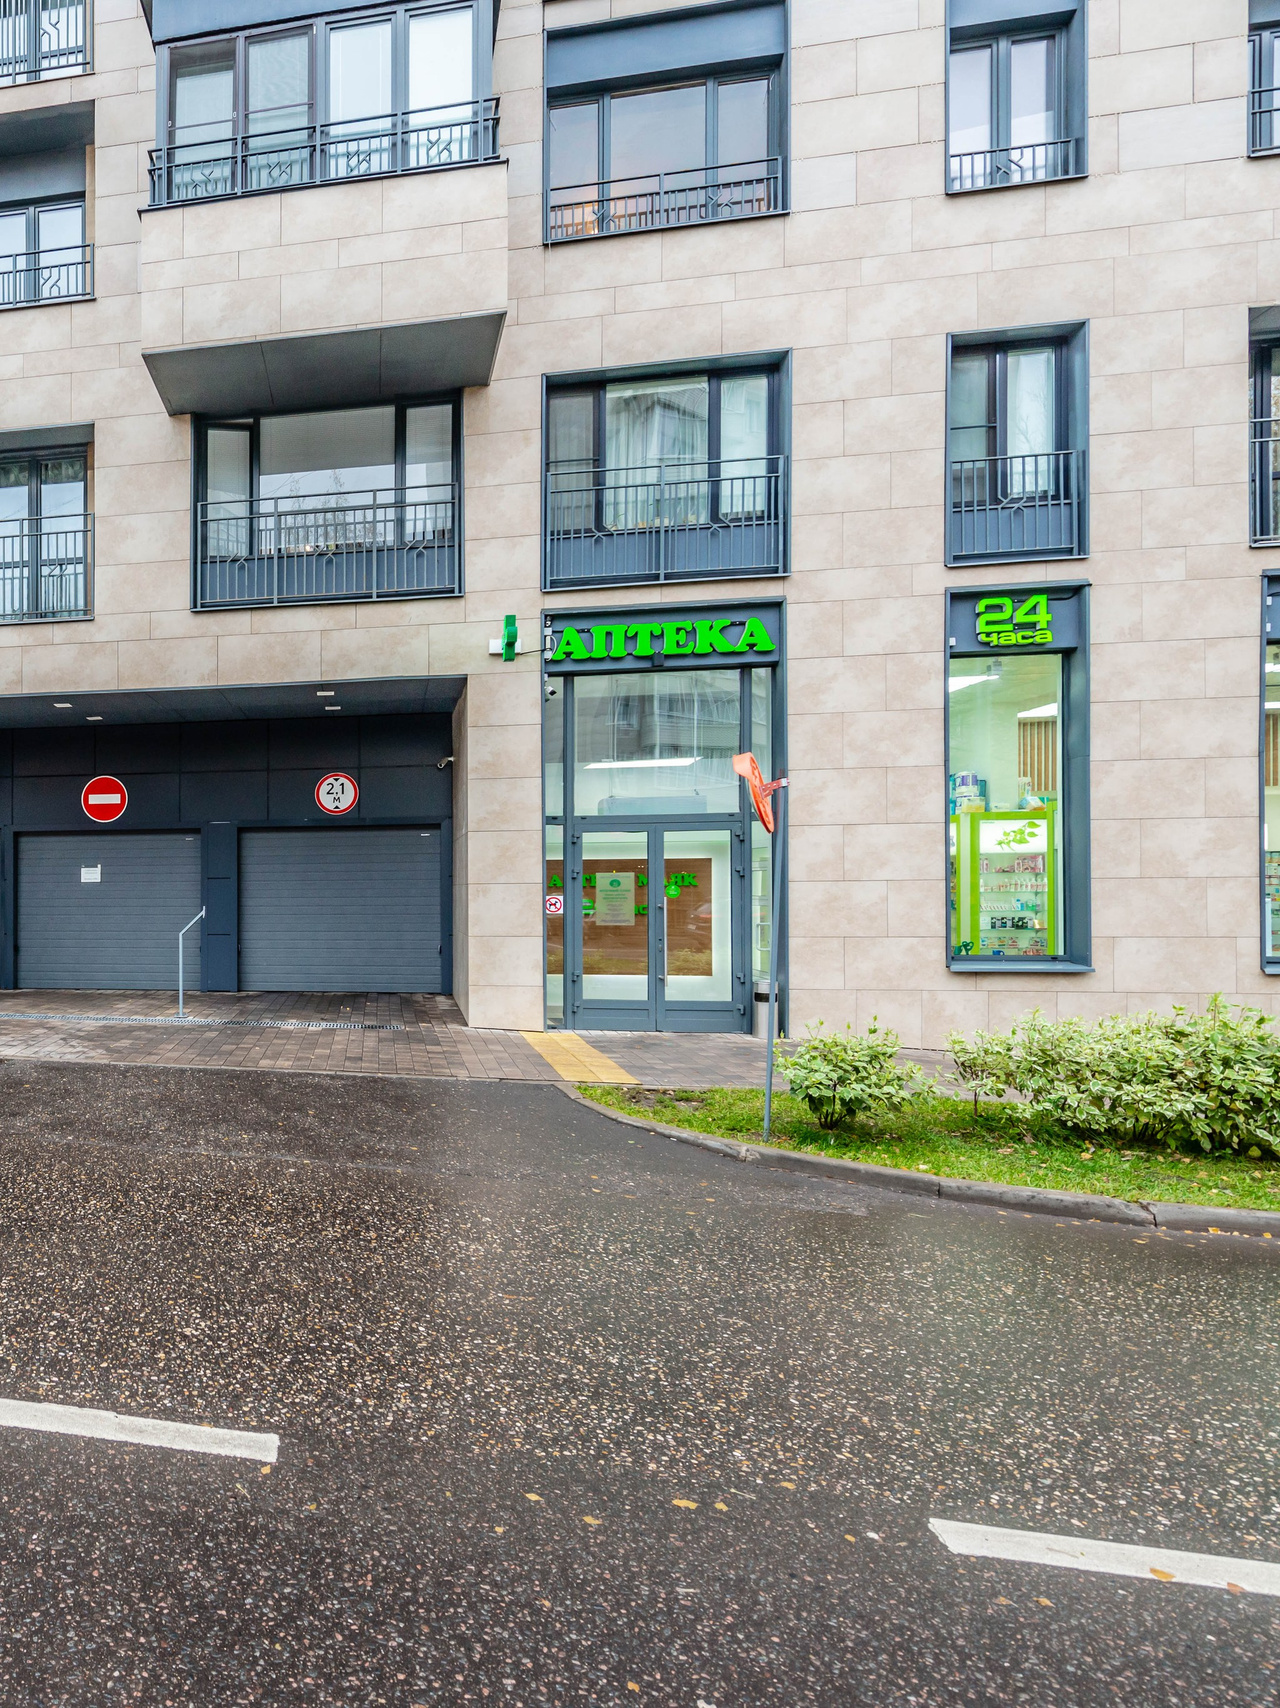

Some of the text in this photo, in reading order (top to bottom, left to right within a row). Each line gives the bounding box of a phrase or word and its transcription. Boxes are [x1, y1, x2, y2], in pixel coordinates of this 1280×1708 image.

[976, 594, 1052, 633] 24
[552, 617, 776, 660] АПТЕКА
[978, 630, 1053, 646] часа
[326, 782, 345, 797] 2,1
[637, 873, 698, 887] МЯК
